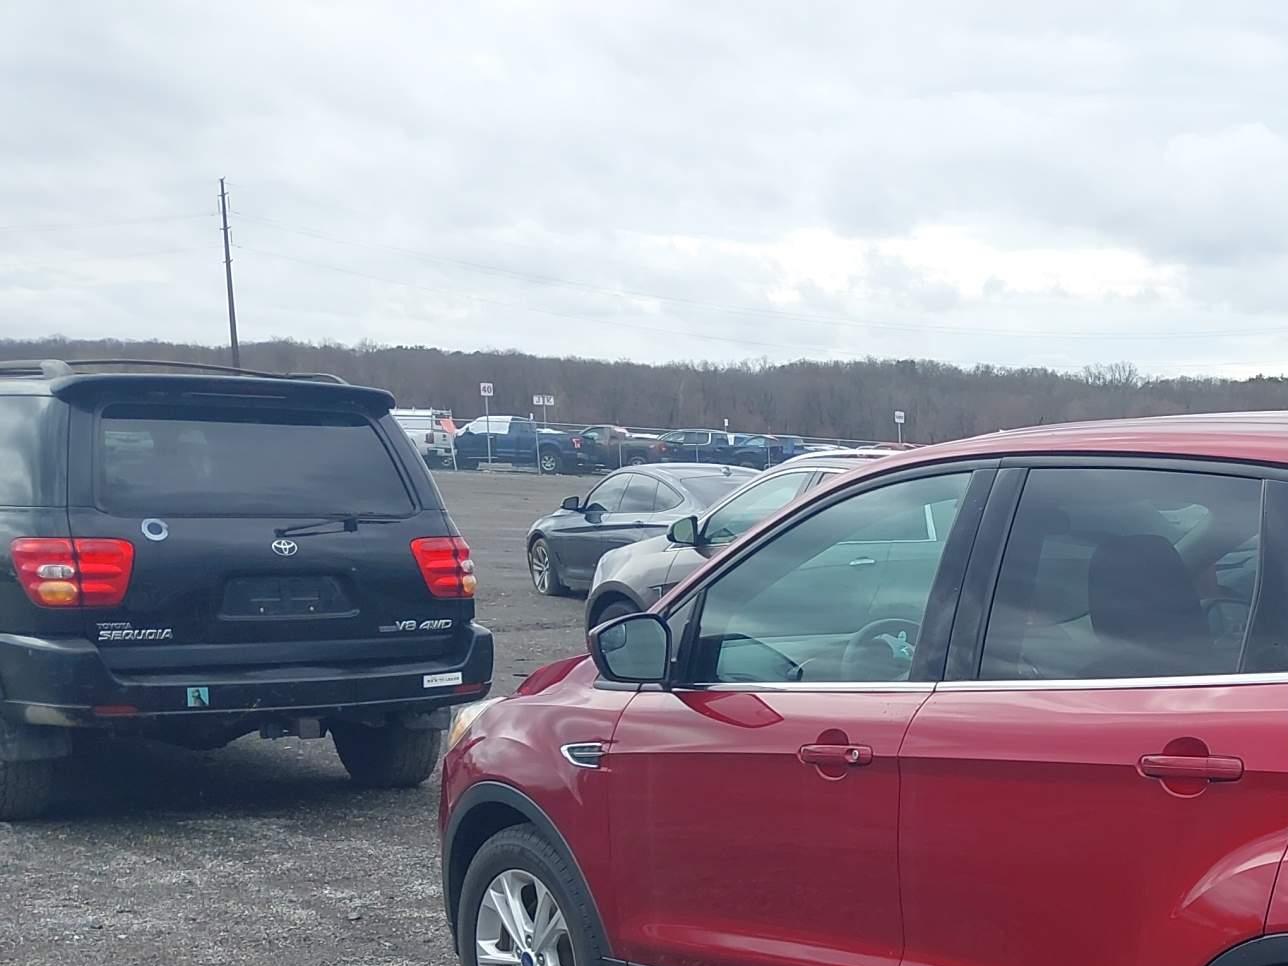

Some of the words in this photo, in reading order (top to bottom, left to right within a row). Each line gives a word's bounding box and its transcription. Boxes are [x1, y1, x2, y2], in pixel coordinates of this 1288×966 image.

[481, 385, 493, 394] 40
[96, 622, 132, 630] TOYOTA
[395, 620, 417, 631] V8
[98, 628, 174, 640] SEQUOIA
